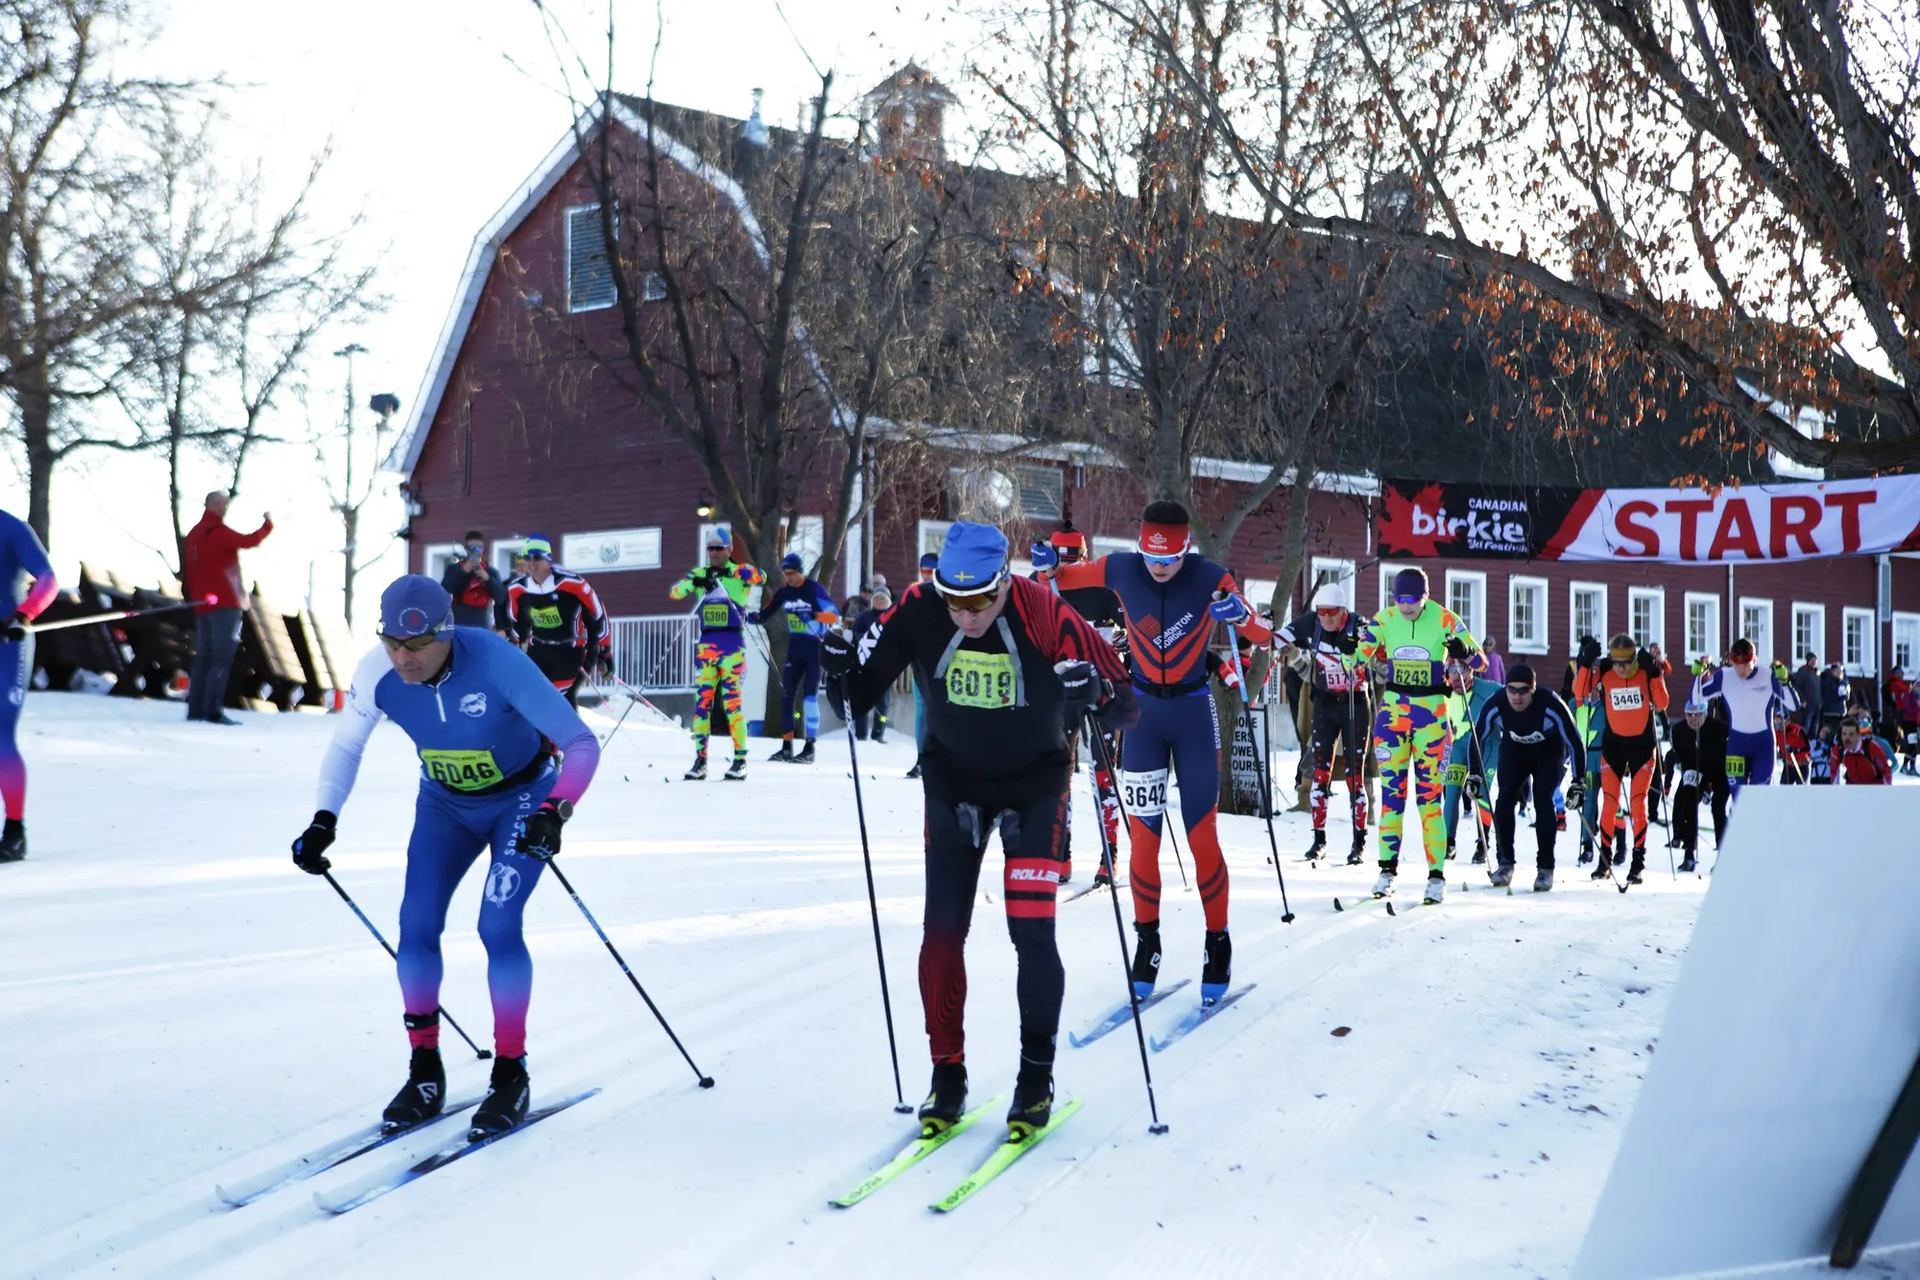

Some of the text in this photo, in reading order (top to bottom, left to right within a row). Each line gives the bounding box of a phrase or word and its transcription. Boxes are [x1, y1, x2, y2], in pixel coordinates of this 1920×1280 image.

[1468, 499, 1528, 512] CANADIAN
[1411, 503, 1526, 543] birkie
[1613, 490, 1878, 561] START
[704, 611, 727, 622] 6300
[950, 667, 1011, 698] 6019
[1395, 668, 1430, 686] 6243
[1613, 694, 1641, 706] 3446
[432, 761, 496, 784] 6046
[1232, 760, 1265, 772] OURSE
[1125, 783, 1166, 807] 3642
